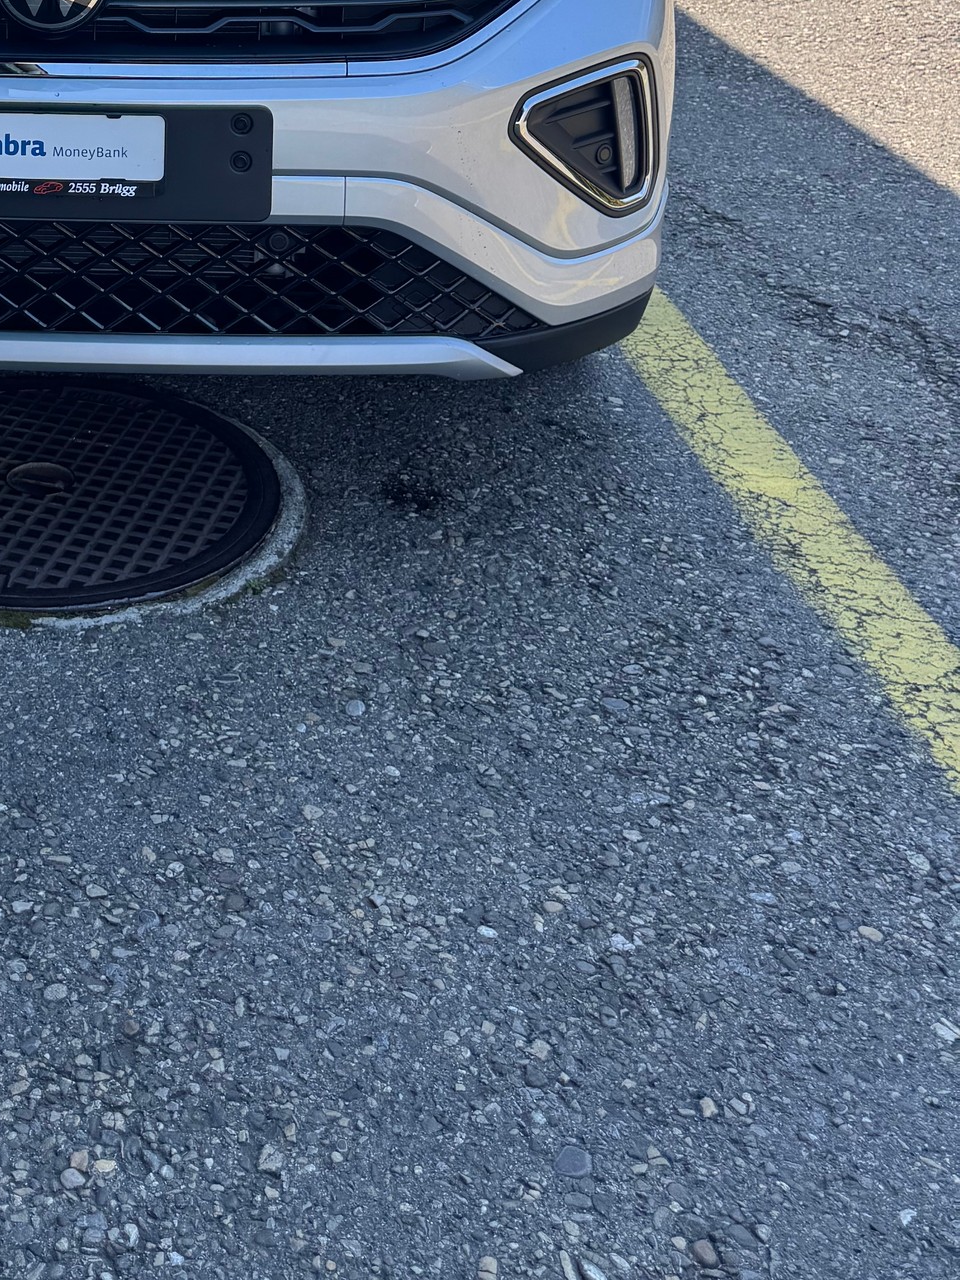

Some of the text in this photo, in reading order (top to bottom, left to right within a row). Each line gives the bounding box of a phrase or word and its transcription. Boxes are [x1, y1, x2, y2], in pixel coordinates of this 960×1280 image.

[52, 146, 128, 161] MoneyBank
[68, 182, 97, 194] 2555
[99, 182, 138, 197] Brügg
